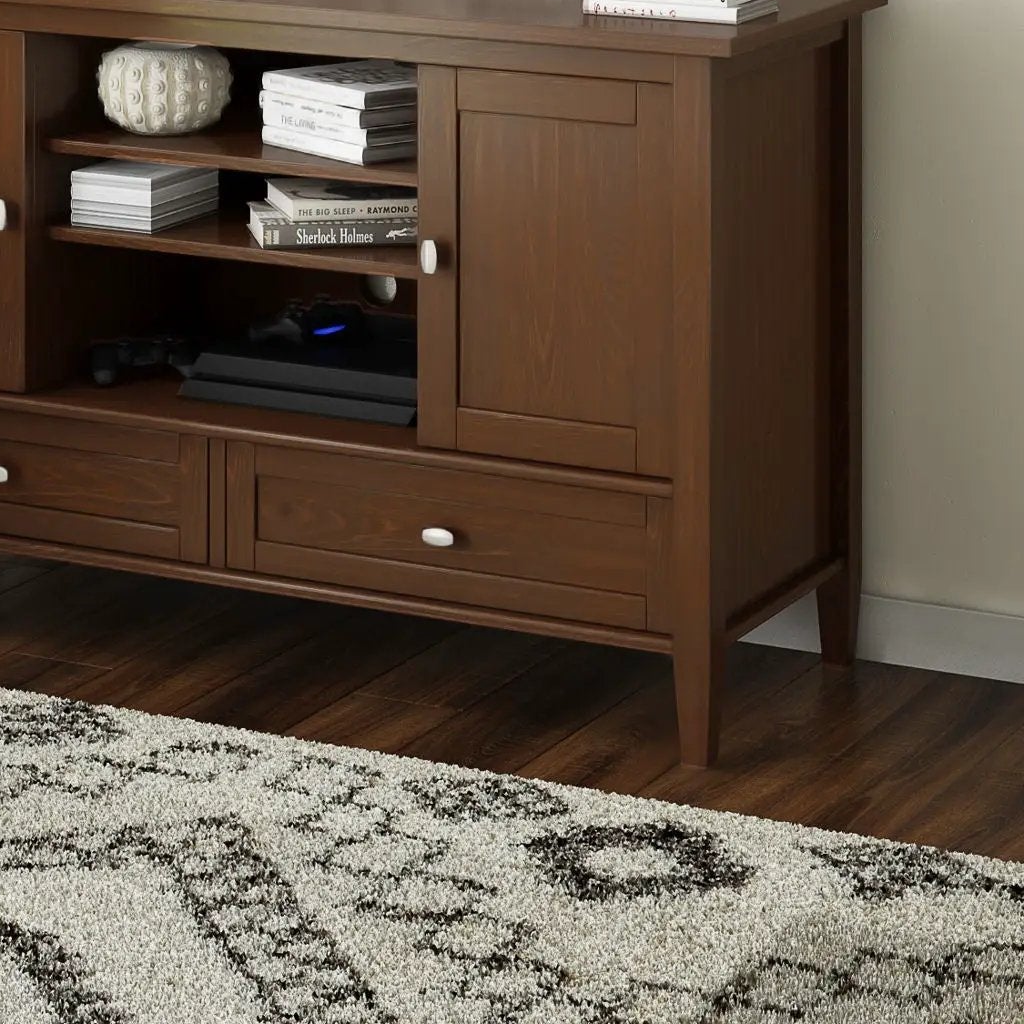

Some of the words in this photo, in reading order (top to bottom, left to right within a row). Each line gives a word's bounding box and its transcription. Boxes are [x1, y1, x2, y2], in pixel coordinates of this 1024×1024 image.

[298, 209, 313, 217] THE
[316, 208, 331, 216] BIG
[333, 207, 356, 215] SLEEP
[367, 206, 410, 214] RAYMOND
[296, 228, 337, 245] Sherlock
[339, 227, 374, 244] Holmes
